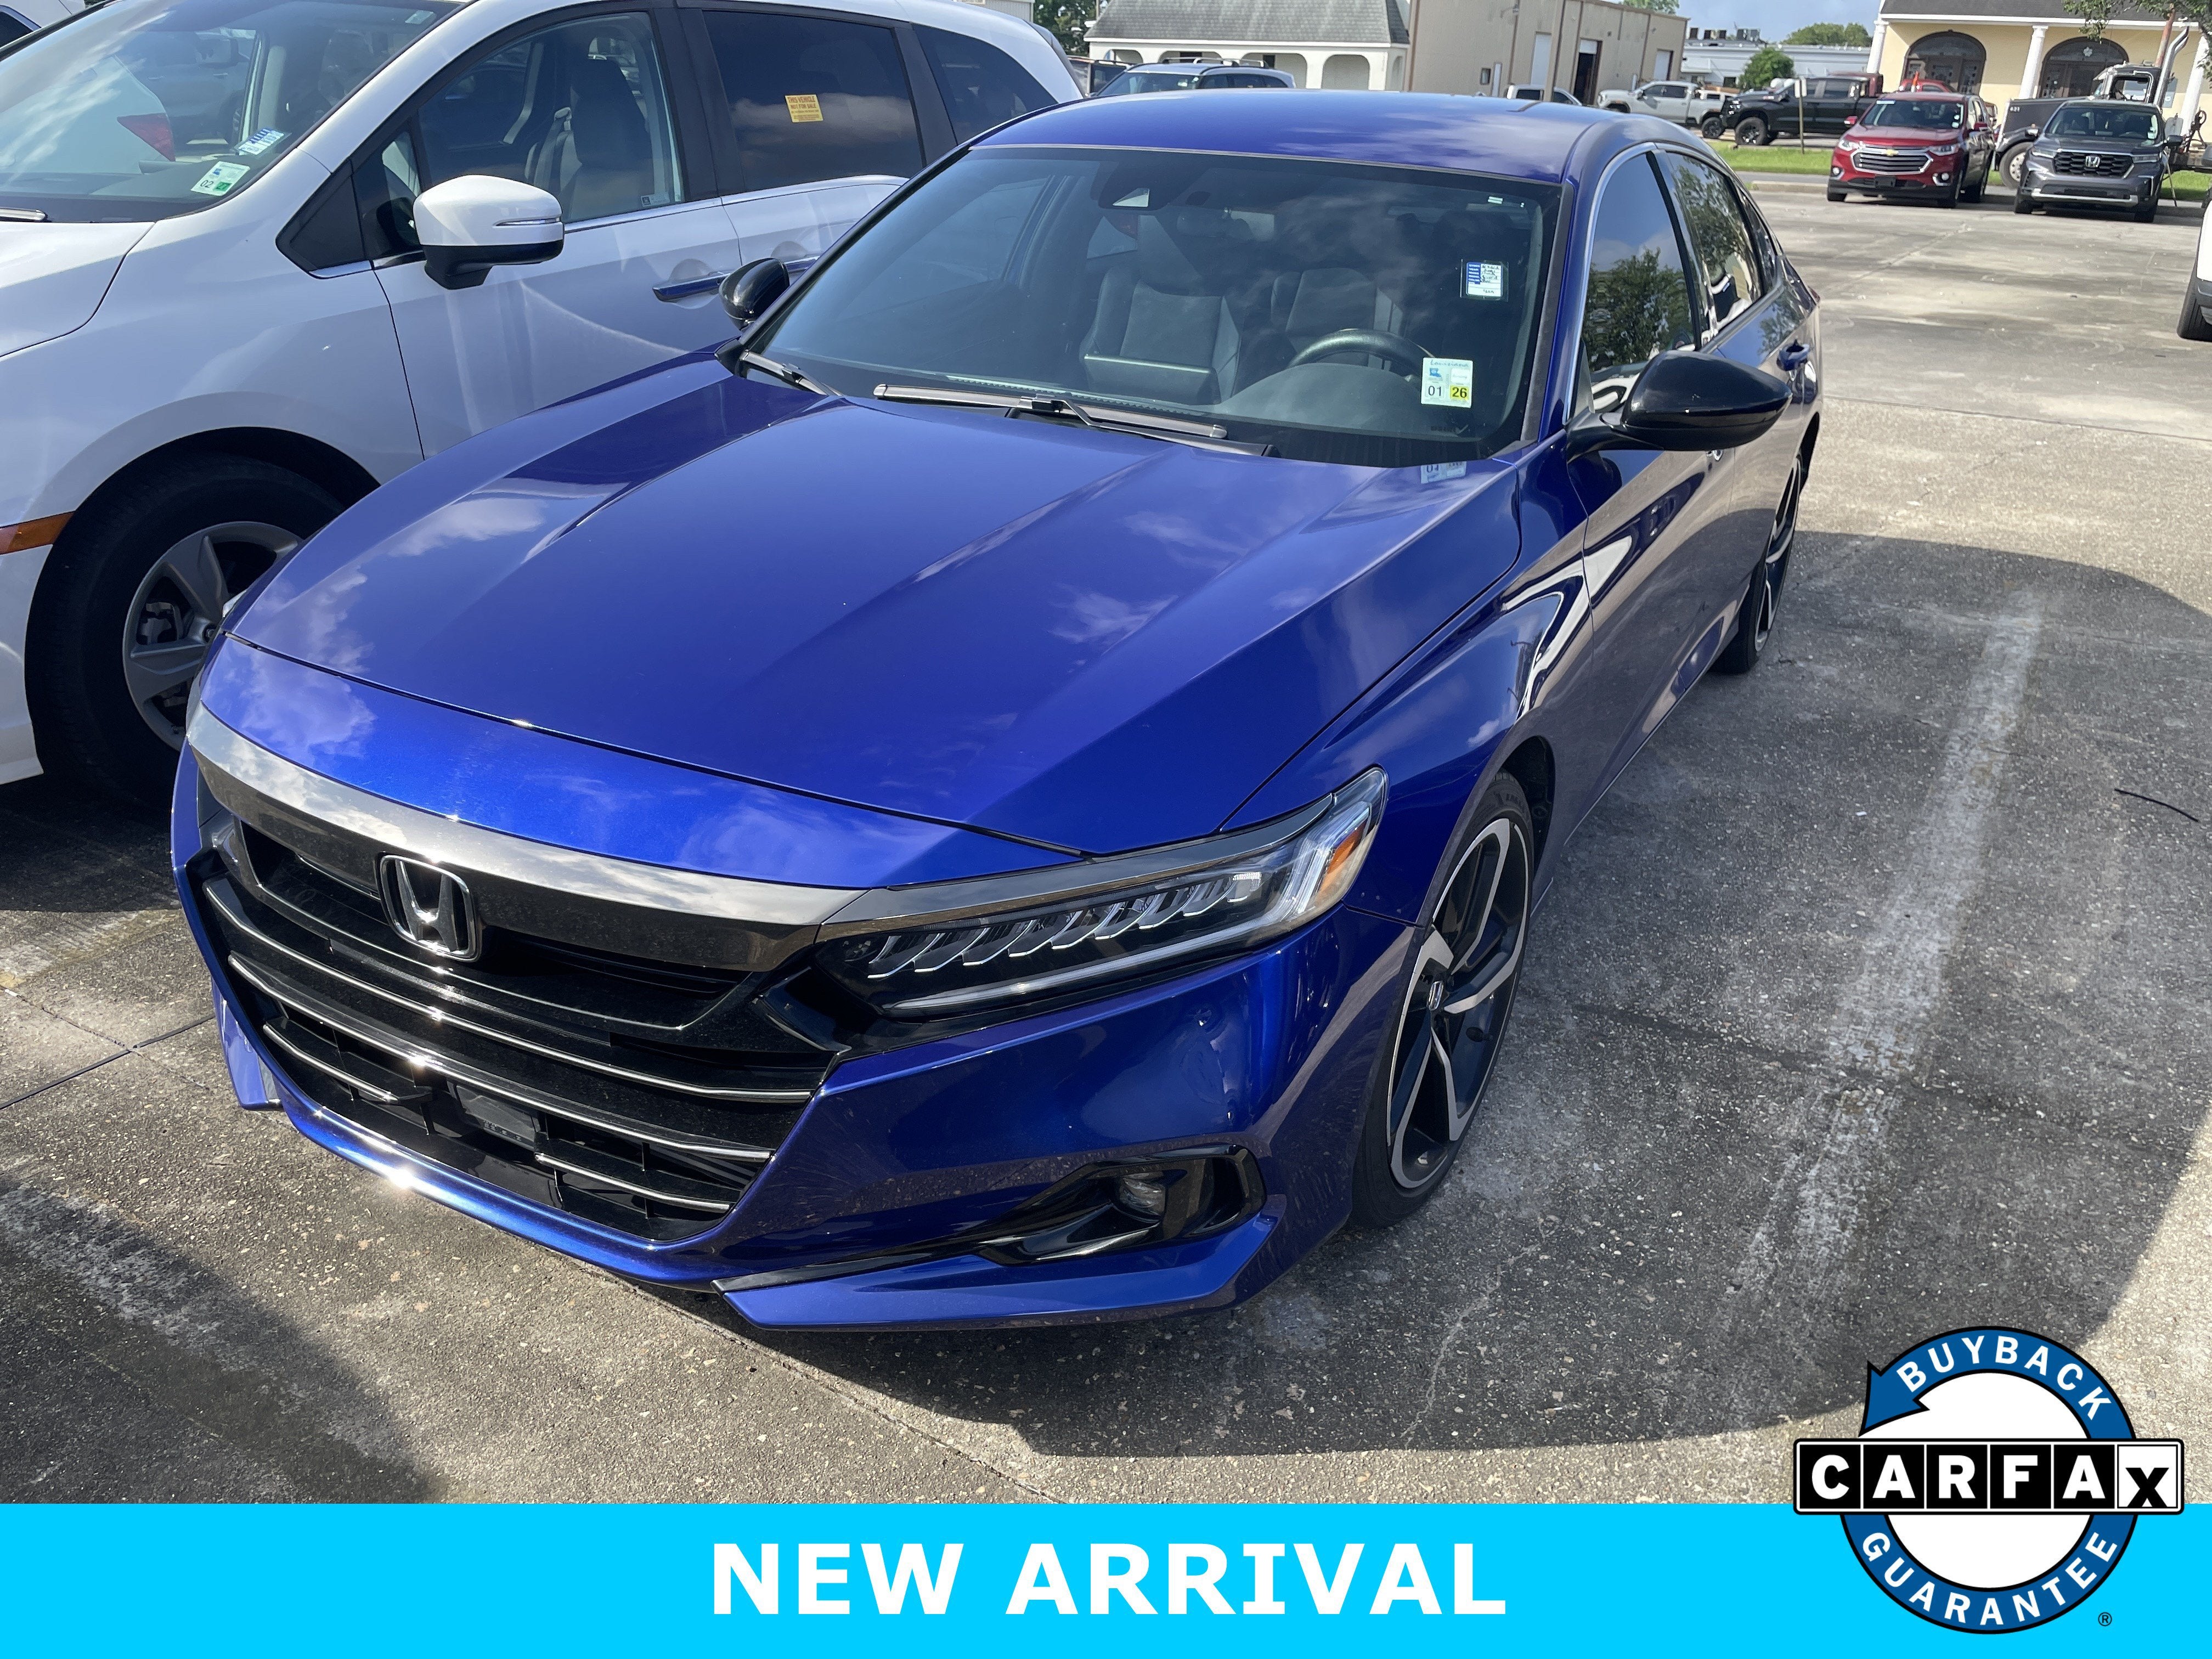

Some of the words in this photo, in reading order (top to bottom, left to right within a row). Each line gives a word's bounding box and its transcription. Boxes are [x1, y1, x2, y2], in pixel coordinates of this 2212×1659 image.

[200, 179, 214, 188] 02
[1428, 386, 1442, 396] 01
[1452, 386, 1468, 398] 26
